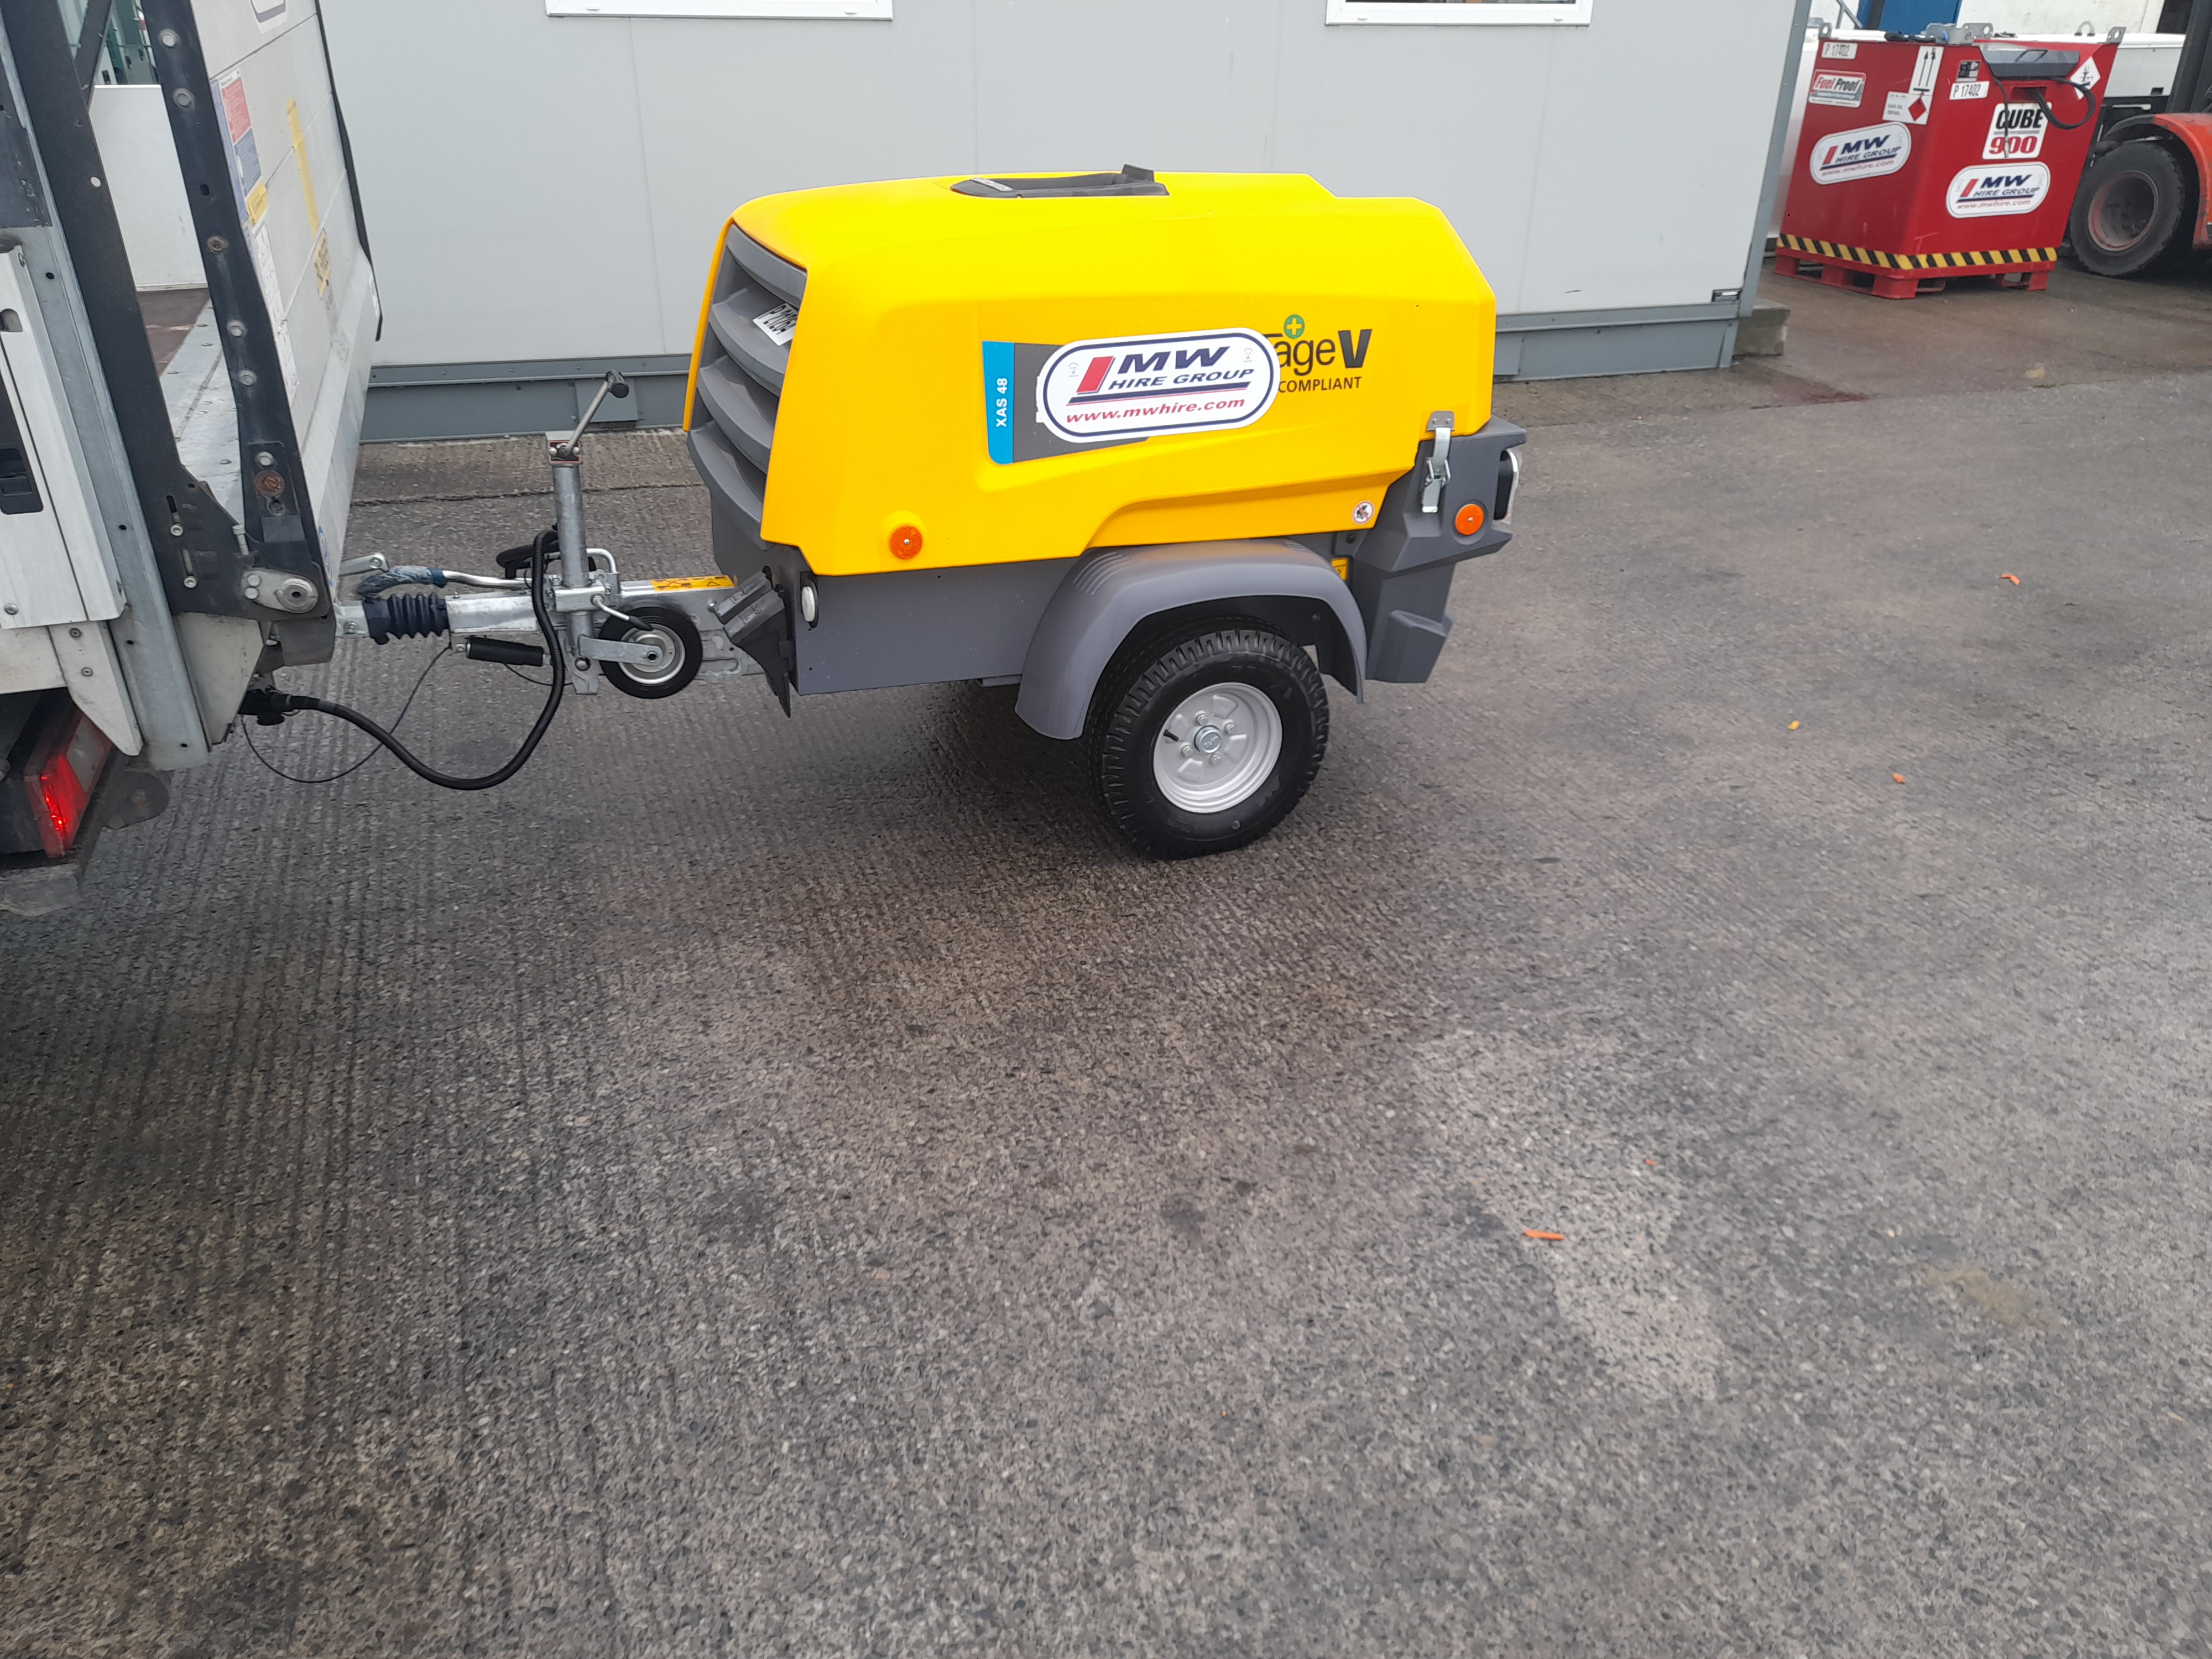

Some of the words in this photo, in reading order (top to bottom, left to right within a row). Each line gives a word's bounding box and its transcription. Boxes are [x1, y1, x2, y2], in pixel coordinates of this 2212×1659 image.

[1953, 85, 1959, 97] P
[1996, 109, 2043, 129] CUBE
[1841, 134, 1891, 154] MW
[1989, 136, 2038, 155] 900
[1835, 153, 1860, 164] HIRE
[1863, 147, 1902, 159] GROUP
[1980, 174, 2033, 189] MW
[2002, 187, 2040, 195] GROUP
[1117, 346, 1230, 374] MW
[1264, 333, 1335, 376] age
[1337, 328, 1373, 369] V
[997, 378, 1008, 394] 48
[1108, 376, 1167, 390] HIRE
[1173, 368, 1255, 383] GROUP
[1278, 377, 1362, 393] COMPLIANT
[996, 398, 1008, 427] XAS
[1067, 398, 1245, 422] www.mwhire.com
